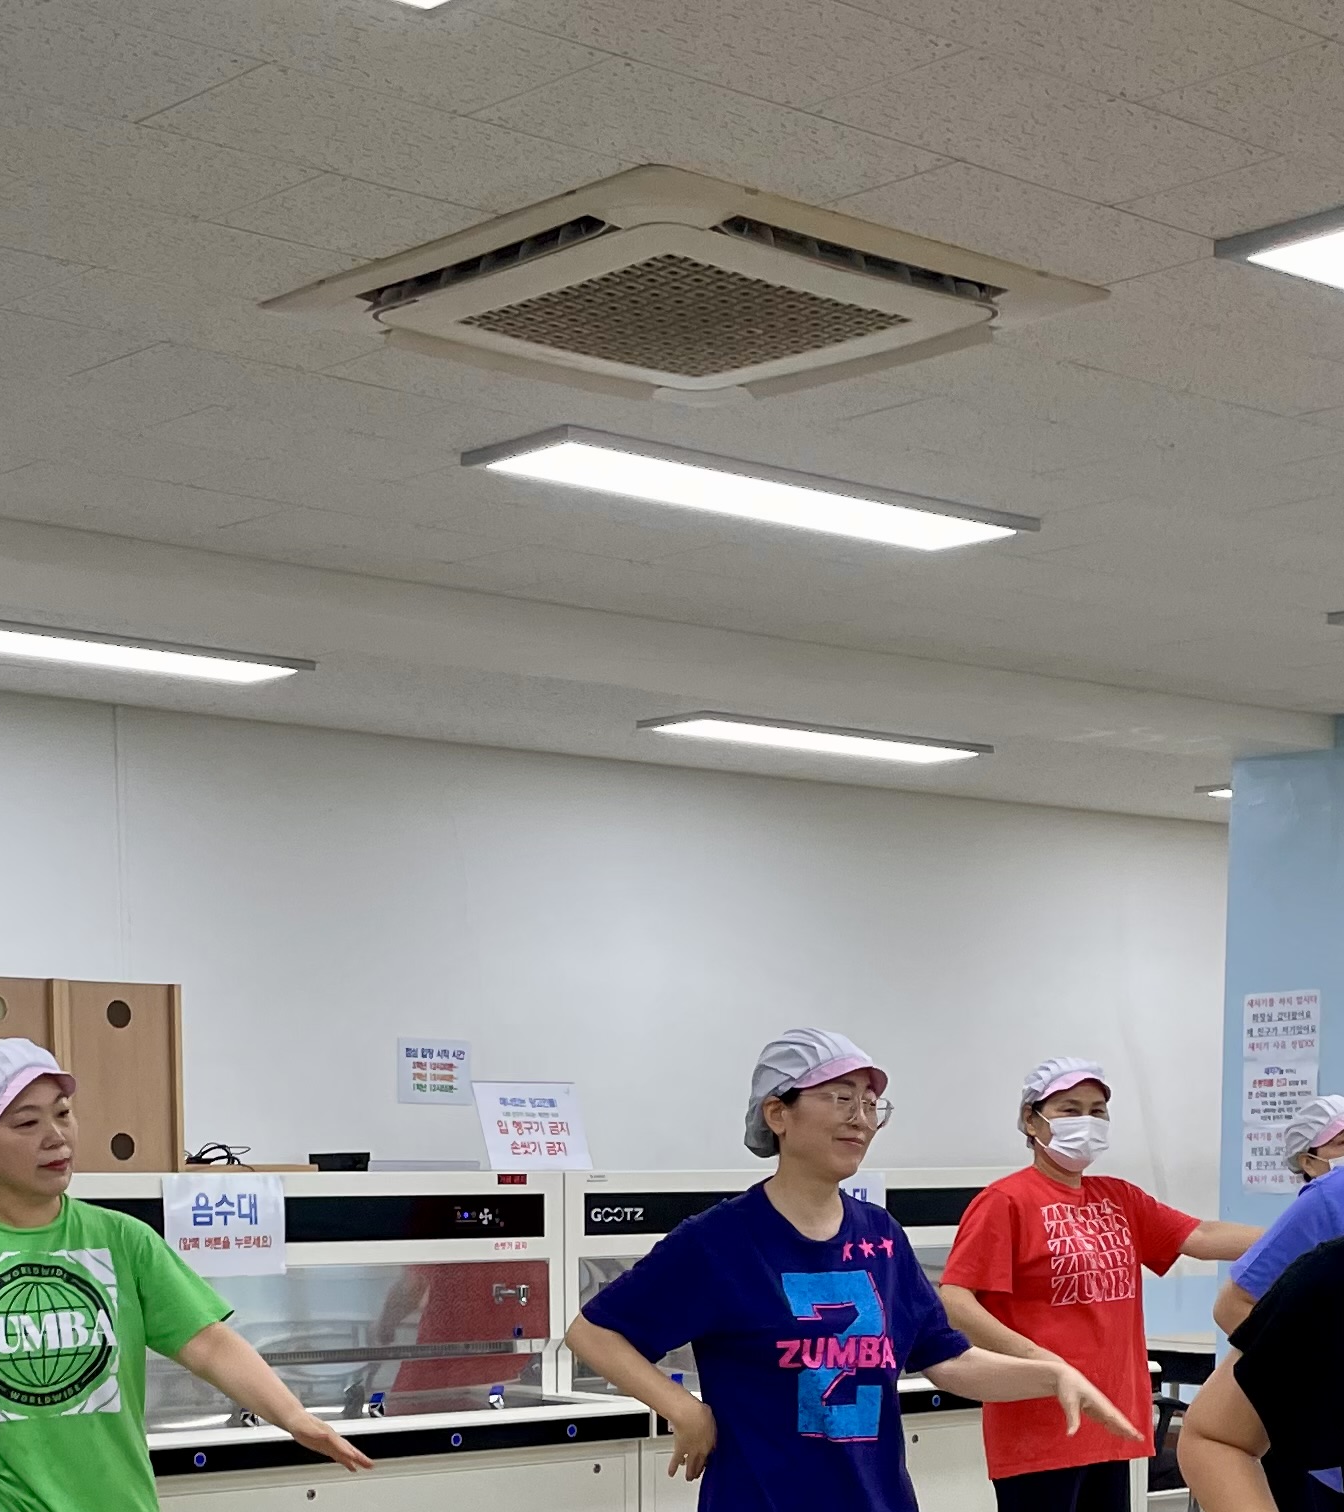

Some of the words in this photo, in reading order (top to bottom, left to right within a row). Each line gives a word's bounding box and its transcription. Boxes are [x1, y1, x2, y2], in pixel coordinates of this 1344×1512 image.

[548, 1121, 570, 1136] 금지
[546, 1141, 567, 1156] 금지
[192, 1192, 258, 1226] 음수대
[235, 1235, 272, 1249] 누르세요)
[776, 1336, 896, 1369] ZUMBA
